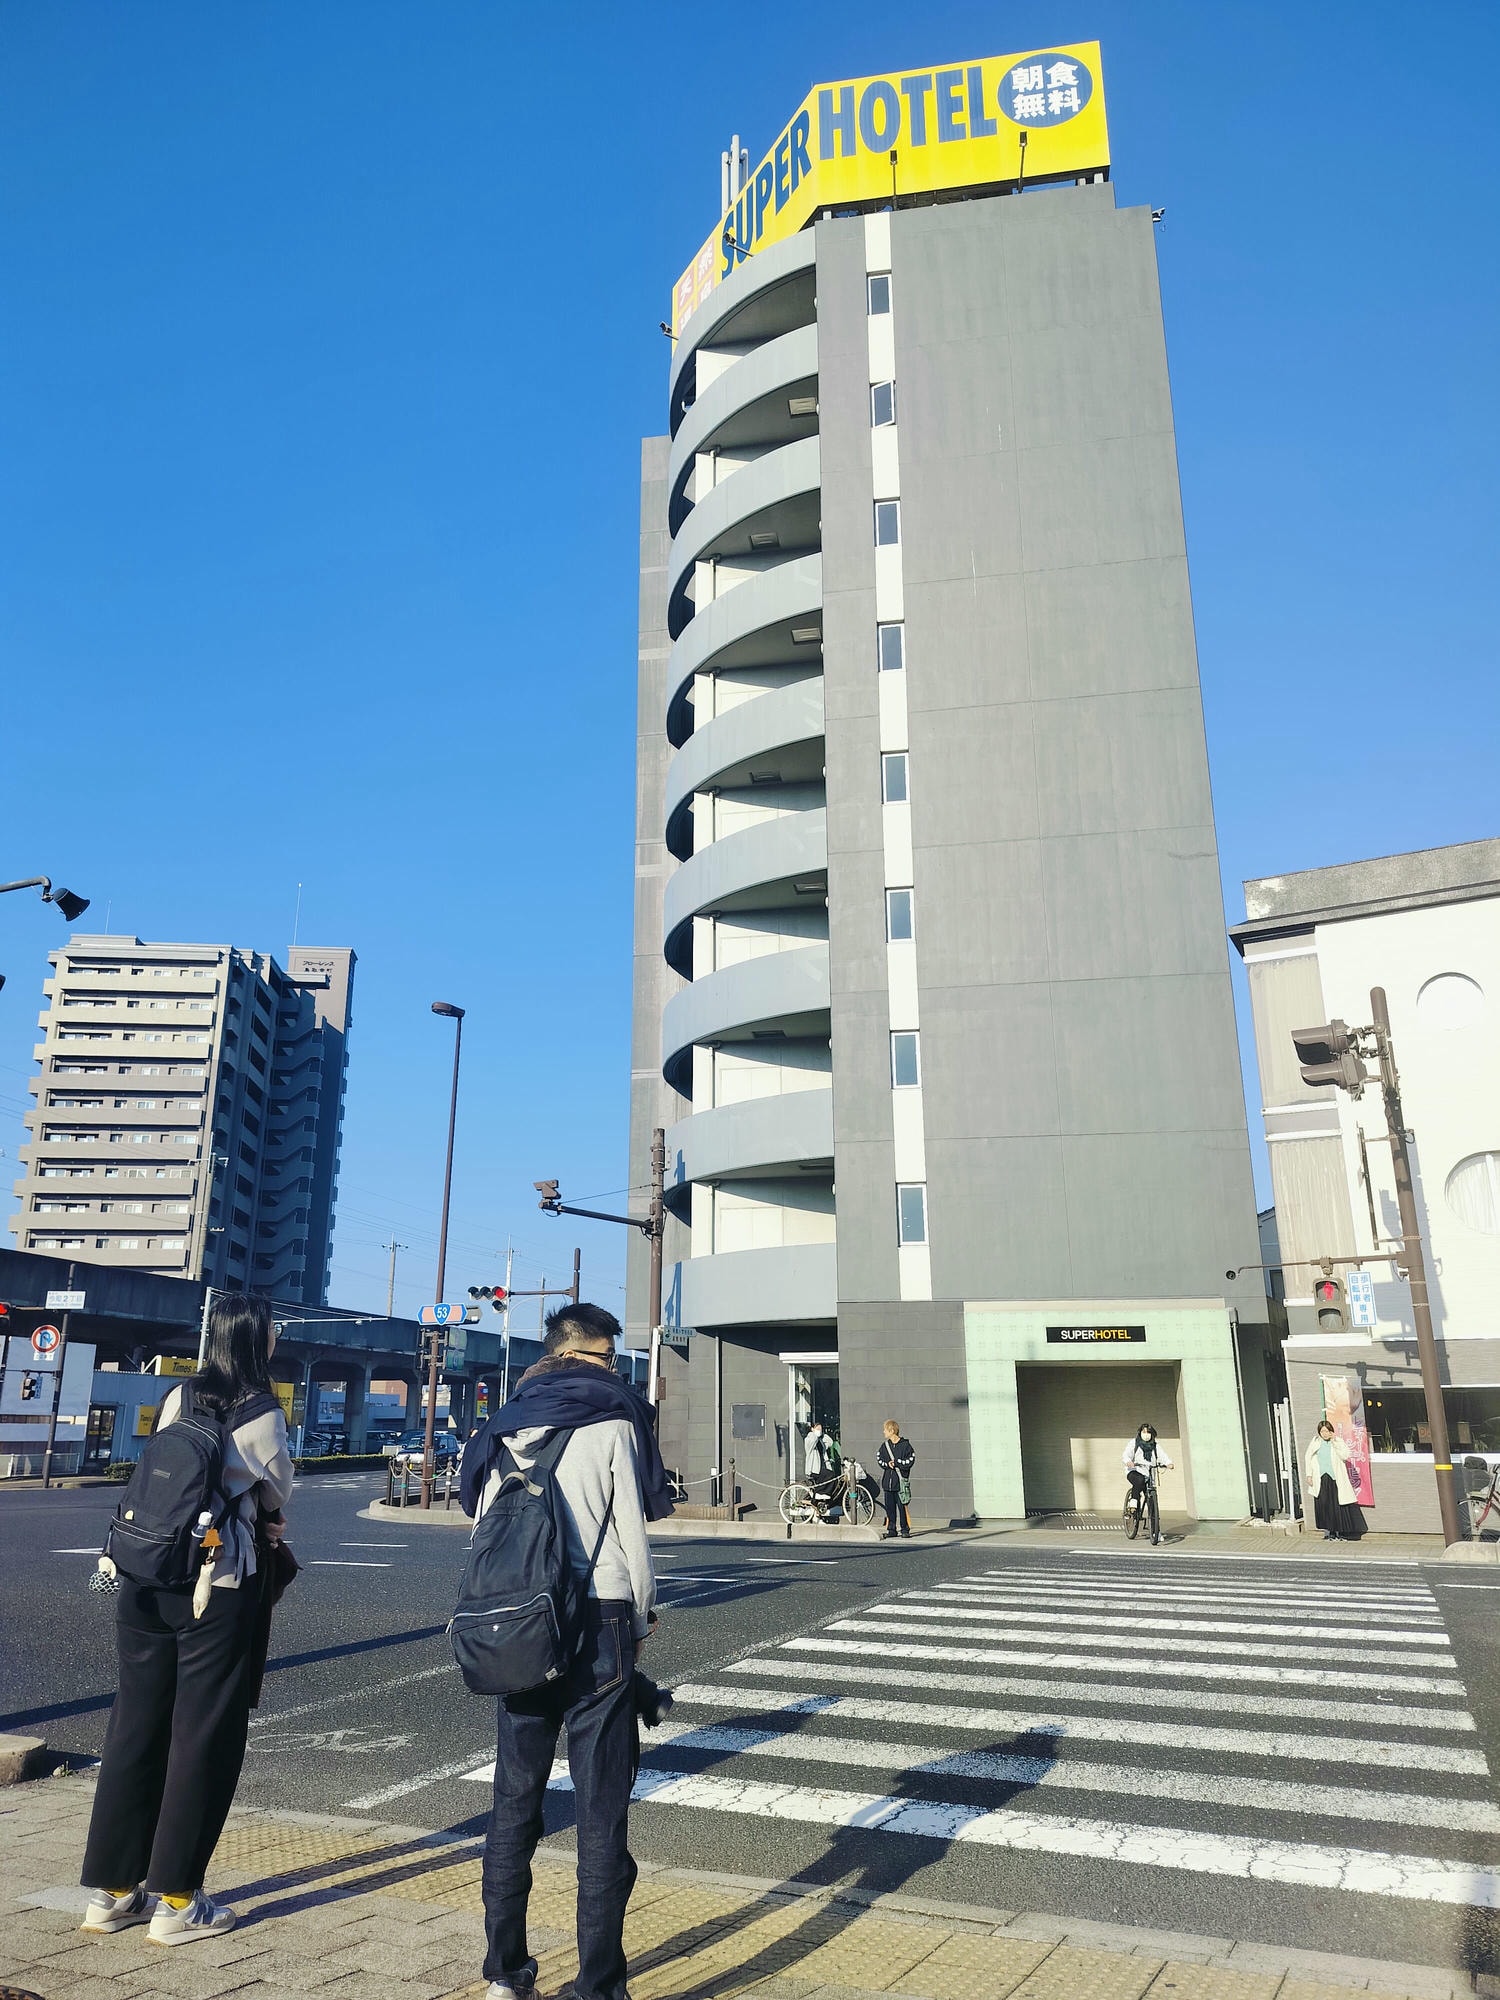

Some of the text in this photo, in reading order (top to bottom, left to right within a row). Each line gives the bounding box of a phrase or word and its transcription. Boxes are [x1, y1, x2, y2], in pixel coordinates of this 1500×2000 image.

[1011, 61, 1079, 93] 朝食
[1013, 87, 1081, 120] 無料
[722, 65, 998, 281] SUPER HOTEL
[437, 1307, 448, 1318] 53
[1061, 1329, 1131, 1340] SUPERHOTEL
[173, 1362, 192, 1373] Times
